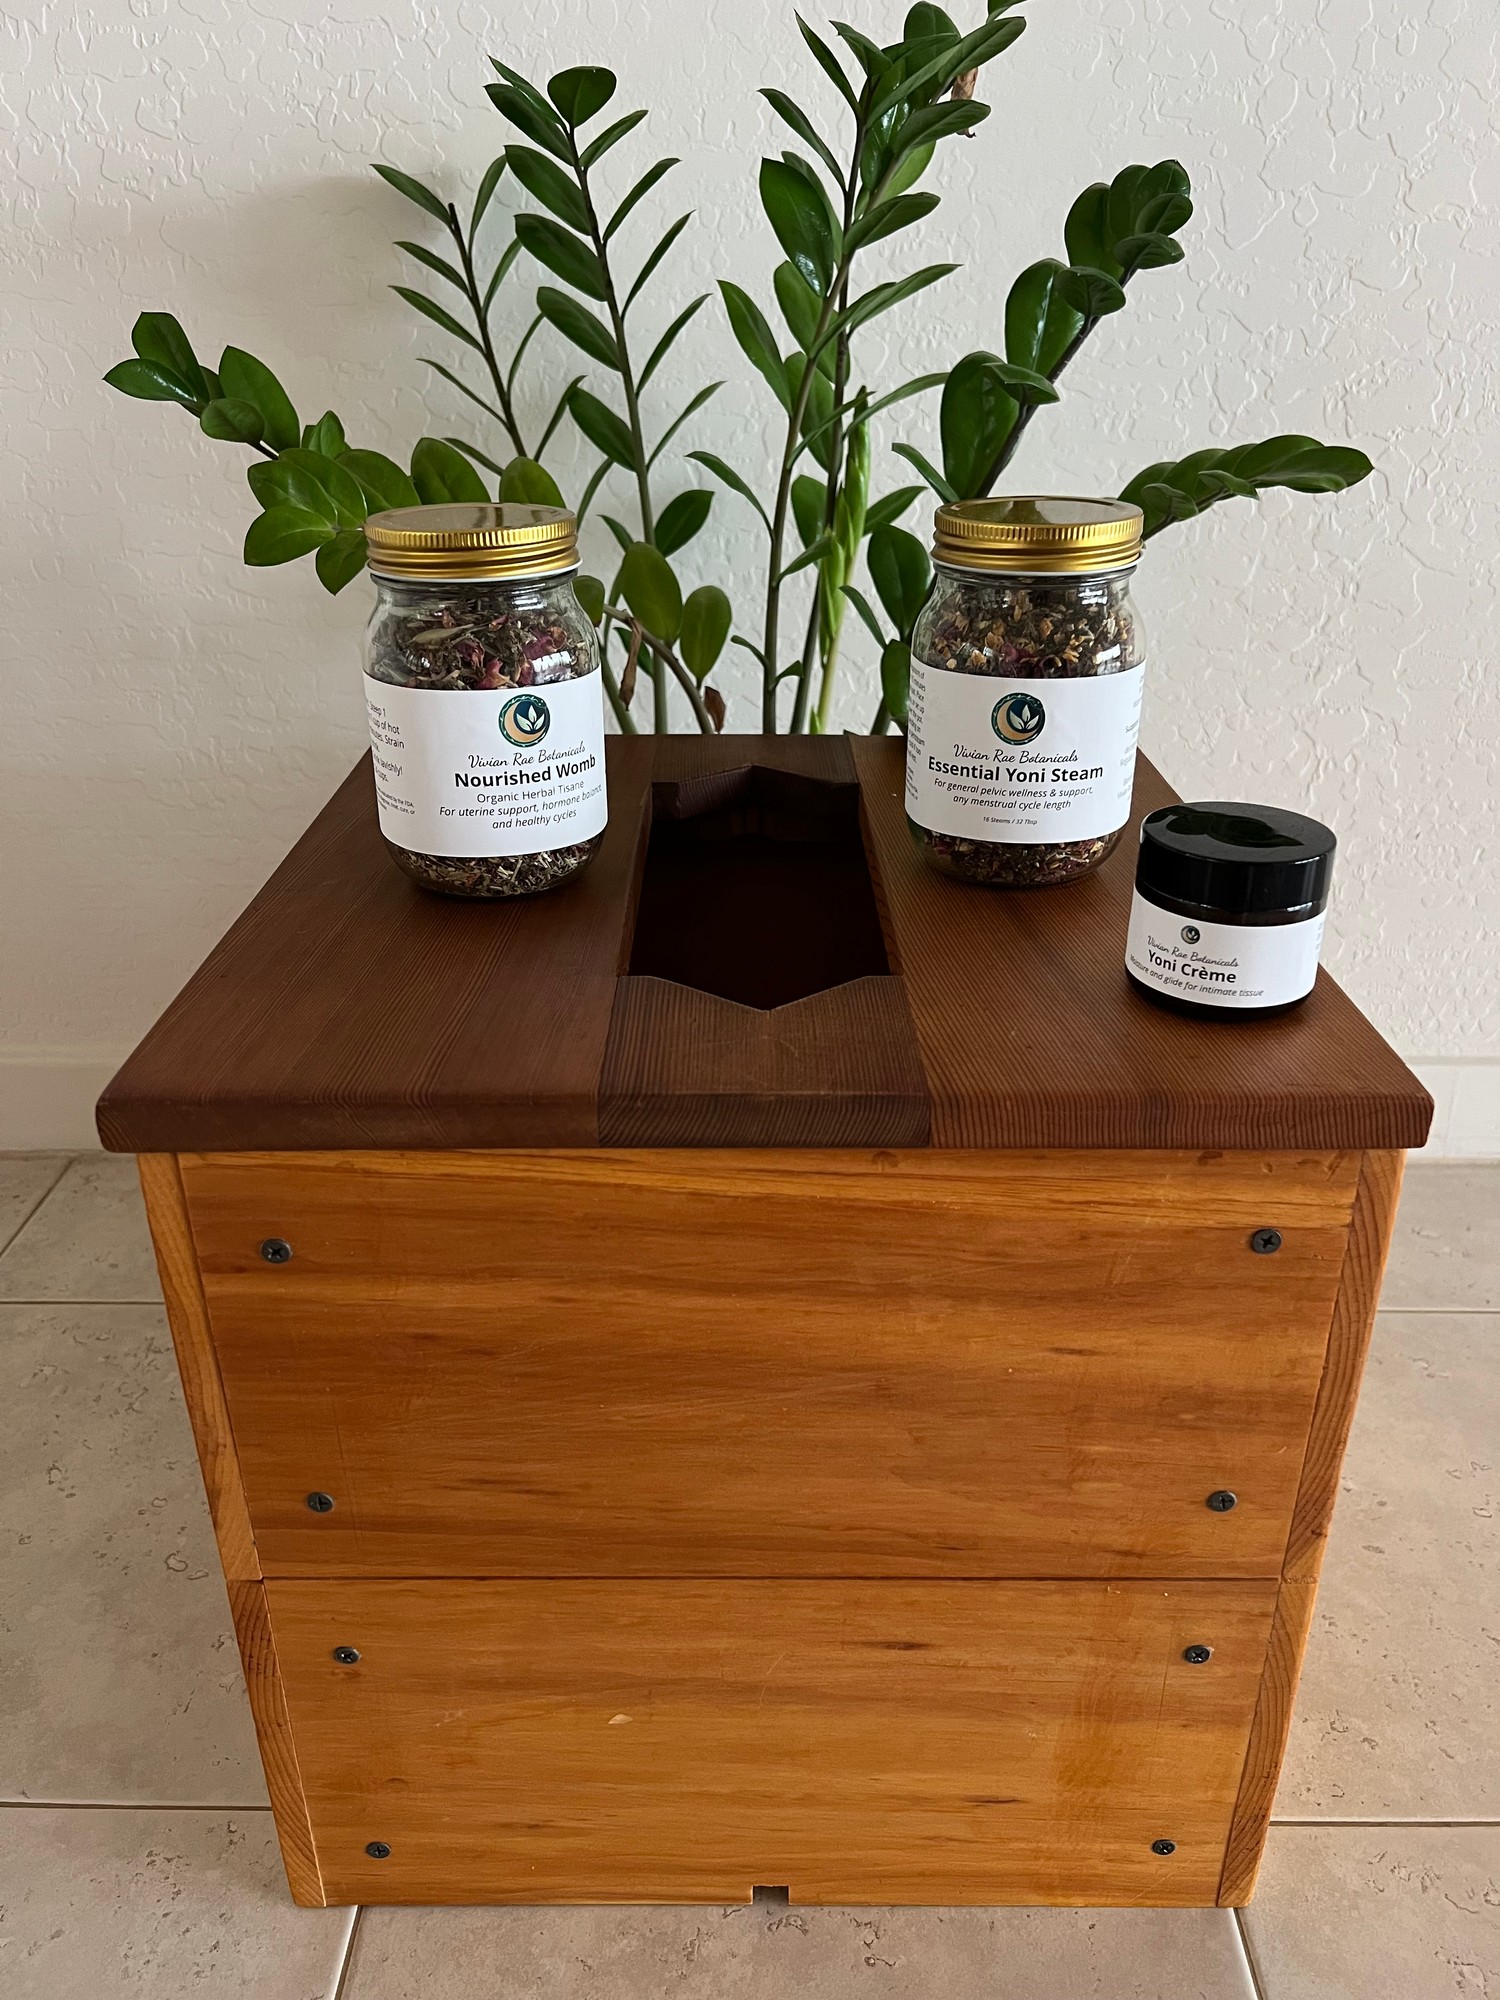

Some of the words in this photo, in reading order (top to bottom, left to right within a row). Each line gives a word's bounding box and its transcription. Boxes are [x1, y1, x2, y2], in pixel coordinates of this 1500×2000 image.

[388, 722, 400, 735] hot
[384, 735, 405, 749] Strain
[468, 754, 508, 768] Vivian
[512, 752, 534, 766] Rae
[538, 740, 586, 764] Botanicals
[954, 744, 990, 760] Vivian
[992, 749, 1015, 763] Rae
[1019, 750, 1079, 764] Botanicals
[454, 766, 551, 787] Nourished
[556, 754, 596, 778] Womb
[928, 756, 1000, 781] Essential
[1006, 768, 1045, 782] Yoni
[1051, 766, 1103, 782] Steam
[476, 792, 519, 805] Organic
[522, 788, 556, 800] Herbal
[558, 780, 584, 794] Tisane
[934, 778, 946, 788] For
[947, 782, 979, 794] general
[980, 786, 1006, 797] pelvic
[1008, 788, 1047, 797] wellness
[1050, 788, 1057, 797] &
[1059, 786, 1093, 798] support,
[439, 806, 456, 816] For
[459, 805, 494, 817] uterine
[498, 804, 539, 817] support,
[542, 796, 580, 811] hormone
[953, 795, 968, 805] any
[970, 797, 1016, 809] menstrual
[1019, 800, 1041, 812] cycle
[1043, 800, 1071, 811] length
[492, 819, 512, 829] and
[516, 815, 550, 827] healthy
[553, 809, 577, 823] cycles
[1148, 935, 1169, 953] Vivian
[1171, 946, 1188, 958] Rae
[1189, 952, 1239, 967] Botanicals
[1148, 949, 1176, 972] Yoni
[1181, 963, 1236, 983] Crème
[1150, 970, 1163, 980] and
[1163, 977, 1183, 987] glide
[1183, 982, 1197, 991] for
[1199, 984, 1237, 997] intimate
[1239, 989, 1264, 997] tissue
